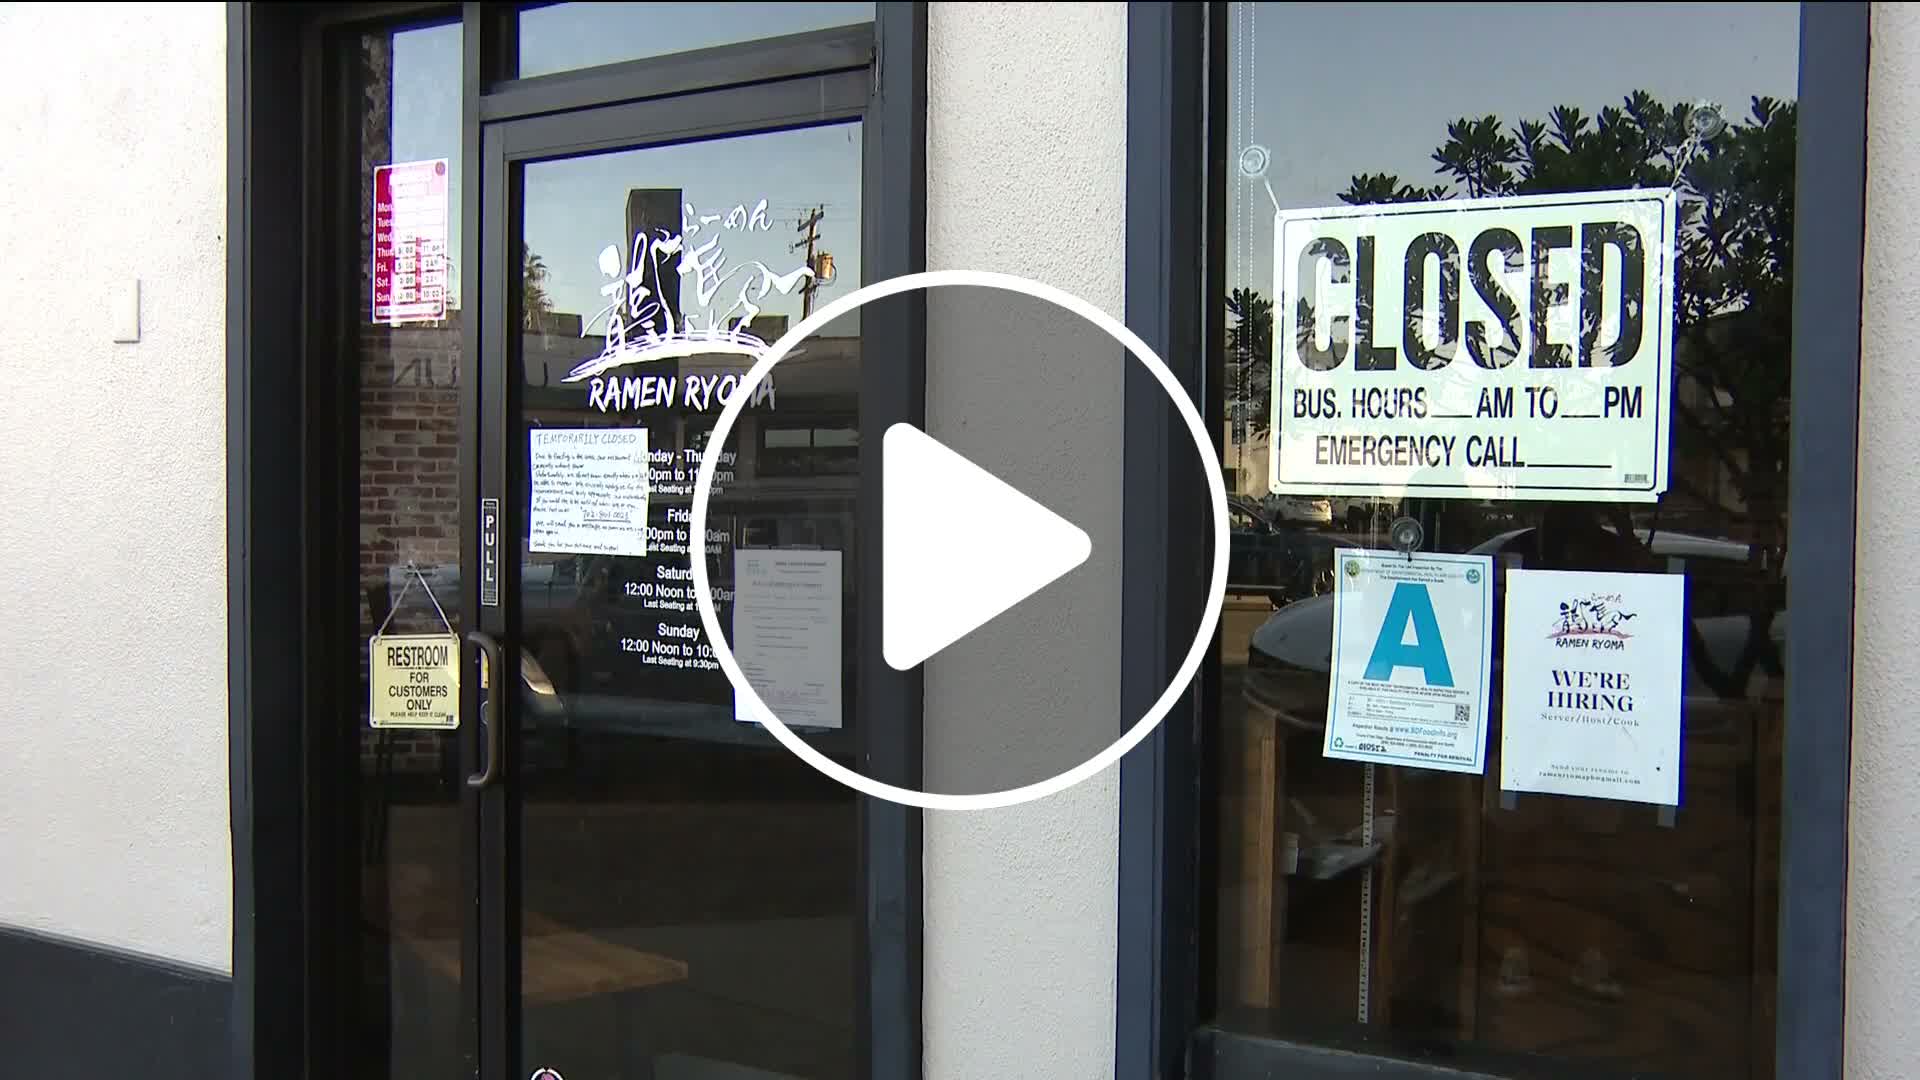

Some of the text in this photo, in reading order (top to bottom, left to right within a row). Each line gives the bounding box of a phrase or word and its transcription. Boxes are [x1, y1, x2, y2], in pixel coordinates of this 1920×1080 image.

[1296, 221, 1645, 372] CLOSED
[589, 376, 677, 413] RAMEN
[1293, 388, 1342, 419] BUS.
[1525, 386, 1558, 418] TO
[536, 432, 637, 446] TEMPORARILY CLOSED
[1315, 435, 1525, 468] EMERGENCY CALL
[674, 467, 685, 480] to
[676, 528, 687, 541] to
[485, 515, 495, 582] PULL
[624, 582, 653, 596] 12:00
[655, 584, 684, 599] Noon
[686, 586, 697, 599] to
[643, 598, 658, 609] Last
[659, 600, 685, 612] Seating
[657, 623, 700, 642] Sunday
[1362, 582, 1455, 688] A
[621, 638, 649, 652] 12:00
[652, 640, 680, 655] Noon
[682, 643, 693, 656] to
[1555, 637, 1625, 651] RAMEN RYOMA
[387, 645, 449, 667] RESTROOM
[642, 654, 657, 664] Last
[658, 656, 683, 668] Seating
[684, 659, 692, 668] at
[410, 672, 429, 683] FOR
[388, 685, 448, 697] CUSTOMERS
[406, 699, 432, 710] ONLY
[1547, 691, 1633, 712] HIRING
[1540, 712, 1640, 727] Server/Host/Cook
